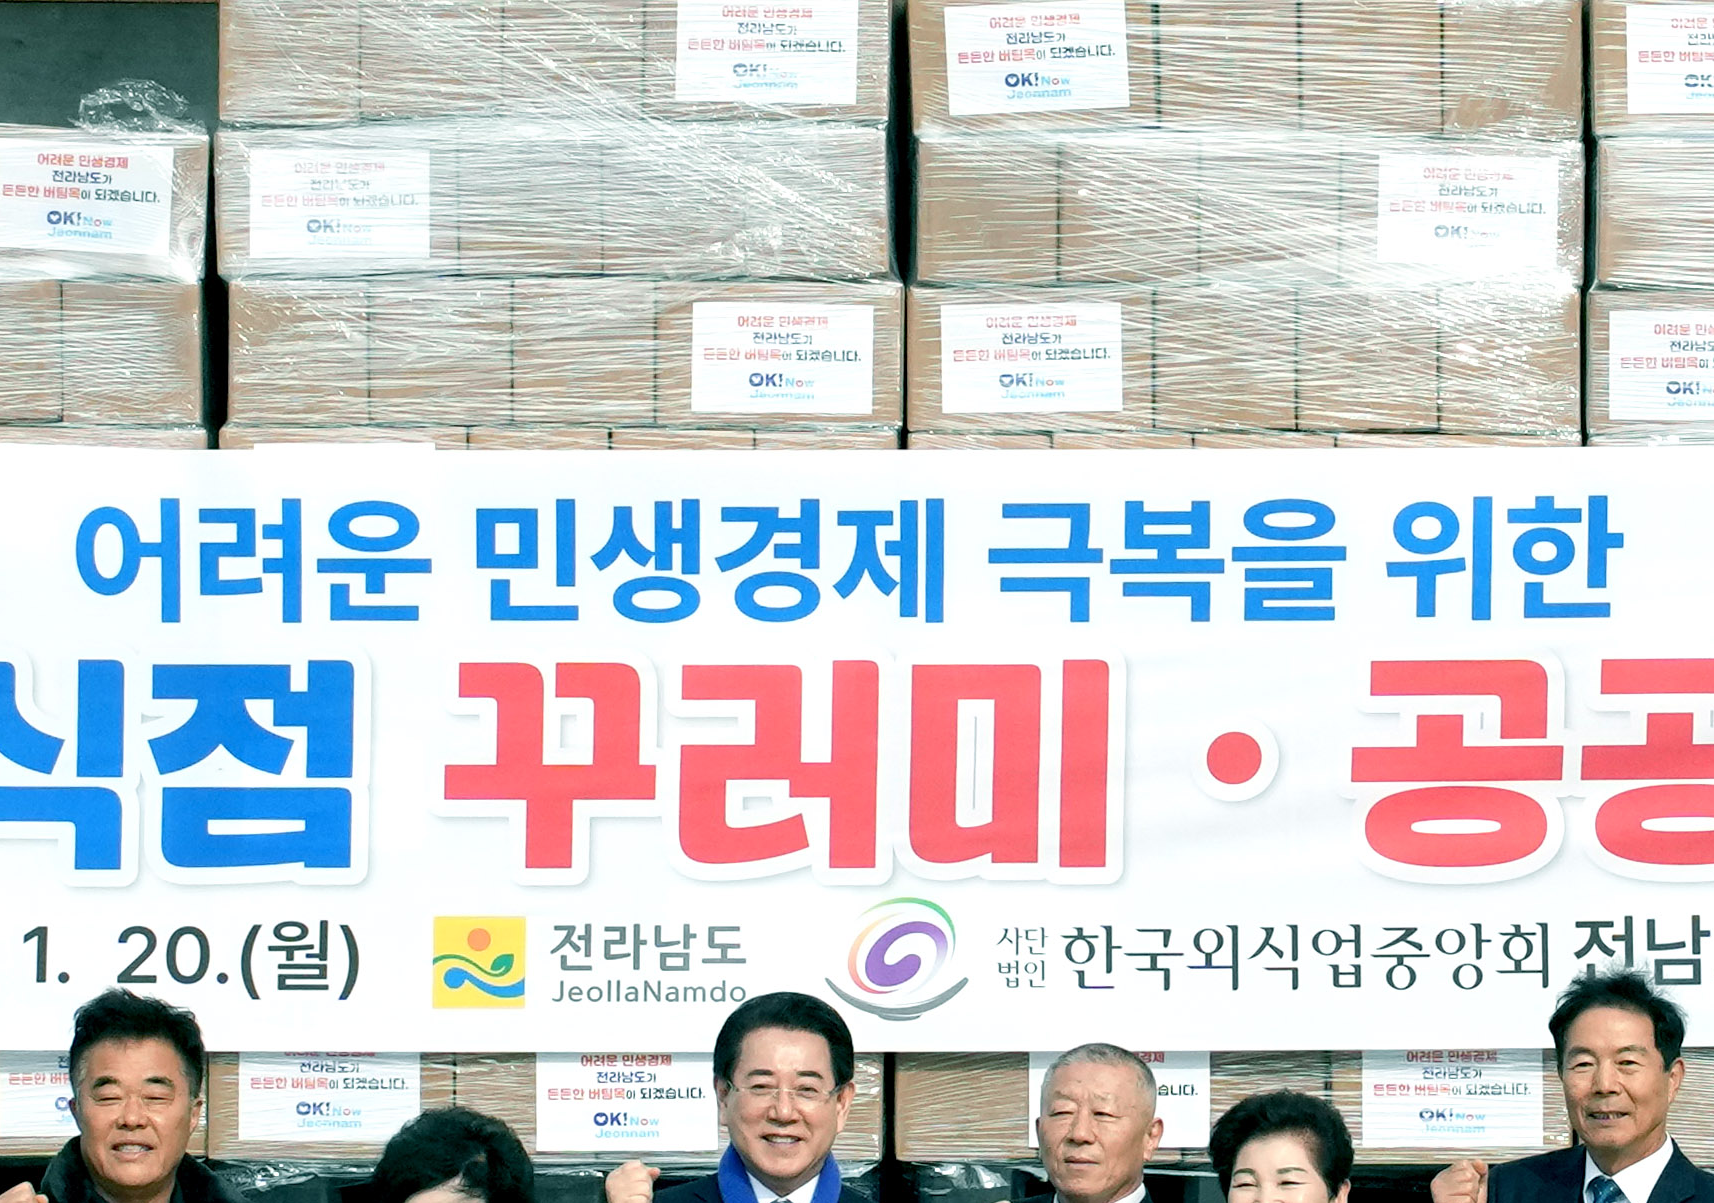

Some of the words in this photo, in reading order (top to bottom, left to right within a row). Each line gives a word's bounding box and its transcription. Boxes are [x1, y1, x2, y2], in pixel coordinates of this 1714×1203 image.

[37, 152, 74, 166] 어려운
[79, 155, 128, 169] 민생경제
[52, 170, 112, 185] 전라남도가
[3, 185, 39, 197] 든든한
[43, 187, 91, 200] 버팀목이
[94, 189, 160, 204] 되겠습니다.
[76, 498, 432, 623] 어려운
[476, 498, 944, 623] 민생경제
[988, 499, 1346, 622] 극복을
[1386, 495, 1624, 621] 위한
[445, 660, 1109, 868] 꾸러미
[550, 923, 747, 972] 전라남도
[997, 926, 1049, 956] 사단
[1062, 923, 1549, 991] 한국외식업중앙회
[997, 959, 1047, 989] 법인
[551, 980, 747, 1003] JeollaNamdo
[580, 1055, 616, 1067] 어려운
[622, 1055, 672, 1067] 민생경제
[596, 1072, 656, 1084] 전라남도가
[548, 1089, 584, 1100] 든든한
[588, 1089, 636, 1100] 버팀목이
[640, 1088, 706, 1100] 되겠습니다.
[594, 1112, 628, 1127] OK!
